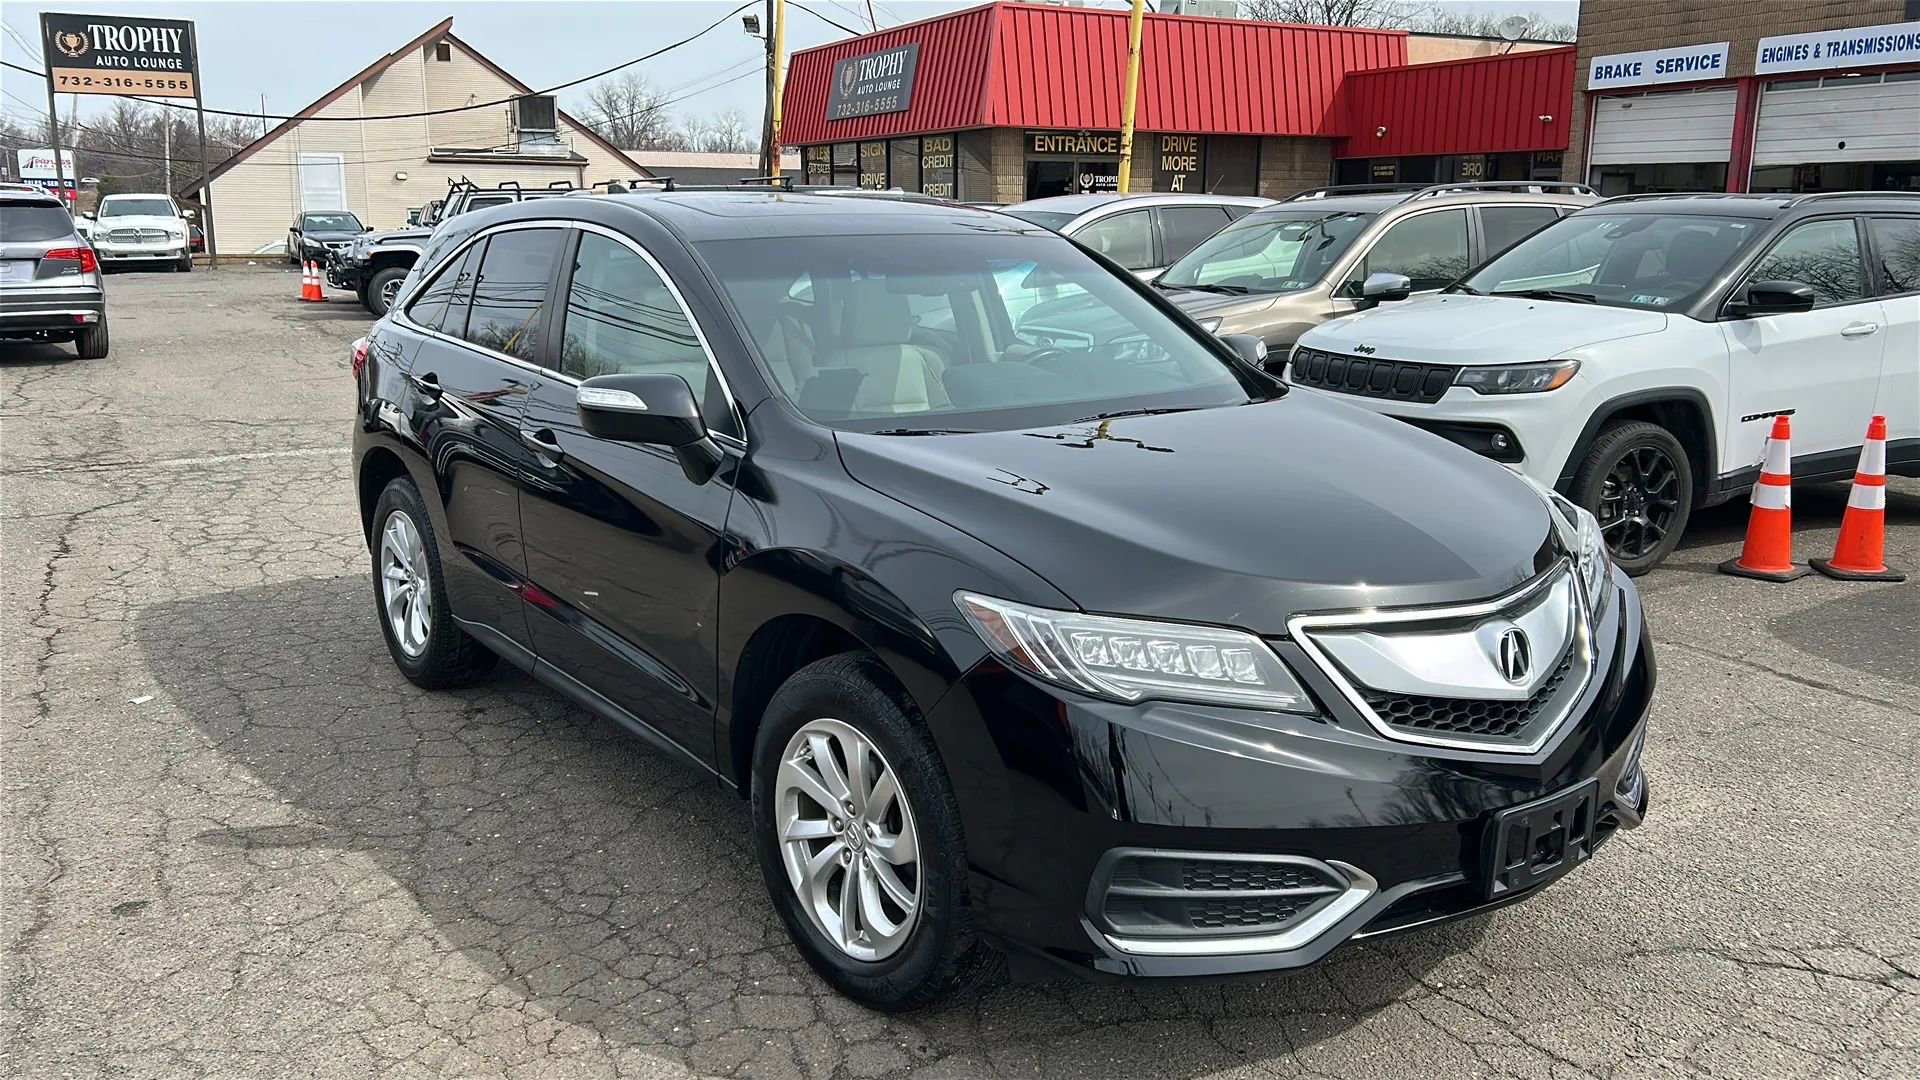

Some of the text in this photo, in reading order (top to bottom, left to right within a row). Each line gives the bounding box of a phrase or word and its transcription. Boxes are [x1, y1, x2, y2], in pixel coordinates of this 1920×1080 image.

[87, 24, 183, 53] TROPHY
[1761, 33, 1920, 63] ENGINES & TRANSMISSIONS
[96, 56, 183, 69] AUTO LOUNGE
[859, 50, 908, 81] TROPHY
[1594, 53, 1721, 80] BRAKE SERVICE
[59, 76, 188, 89] 732-316-5555
[857, 79, 901, 95] AUTO LOUNGE
[836, 96, 898, 117] 732-316-5555
[860, 143, 886, 157] SIGN
[924, 139, 951, 153] BAD
[1034, 135, 1117, 153] ENTRANCE
[1162, 136, 1198, 152] DRIVE
[922, 154, 954, 169] CREDIT
[1161, 156, 1197, 171] MORE
[860, 173, 886, 185] DRIVE
[1170, 174, 1186, 191] AT
[923, 183, 953, 197] CREDIT
[1354, 344, 1376, 355] Jeep
